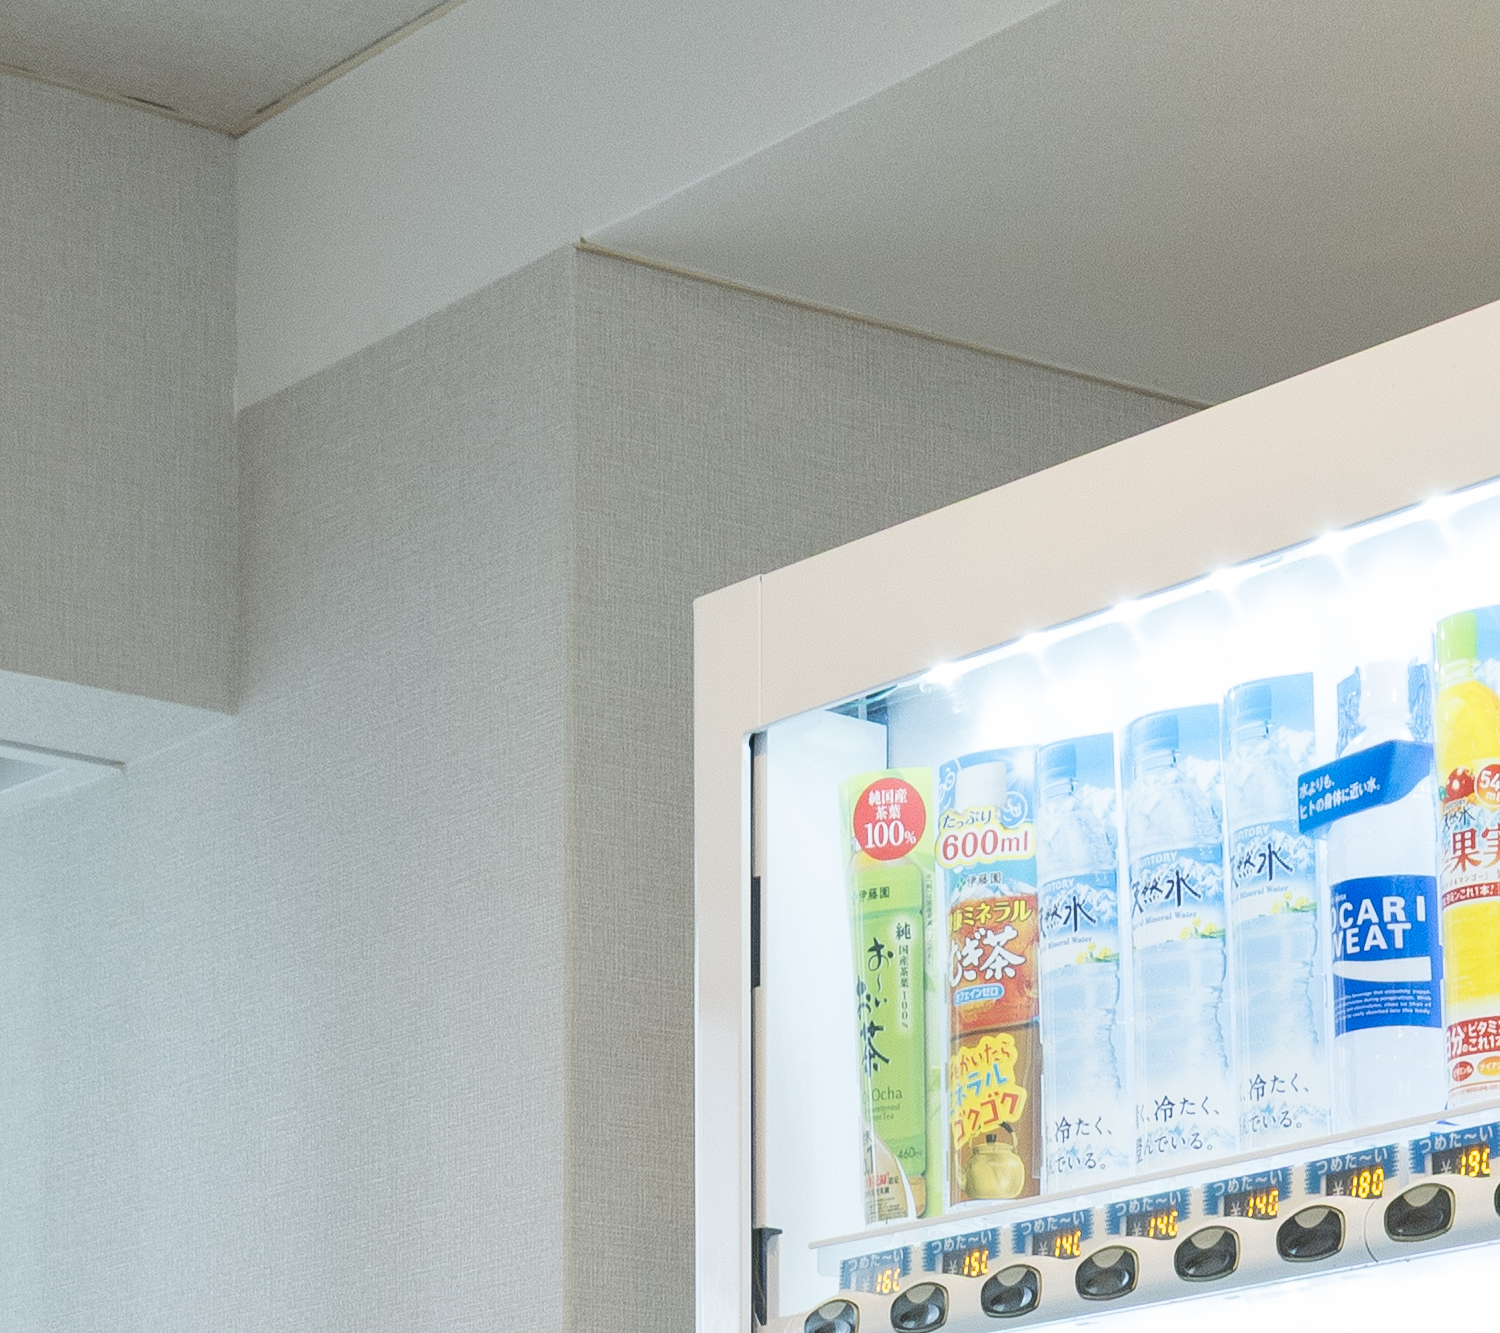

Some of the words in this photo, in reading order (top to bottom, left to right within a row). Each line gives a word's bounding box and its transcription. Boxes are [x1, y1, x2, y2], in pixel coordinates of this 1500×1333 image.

[868, 788, 908, 806] 純国産
[875, 805, 901, 820] 茶葉
[943, 808, 992, 829] たっぷり
[864, 820, 917, 849] 100%
[942, 829, 1028, 861] 600ml
[967, 871, 1002, 888] 伊藤園
